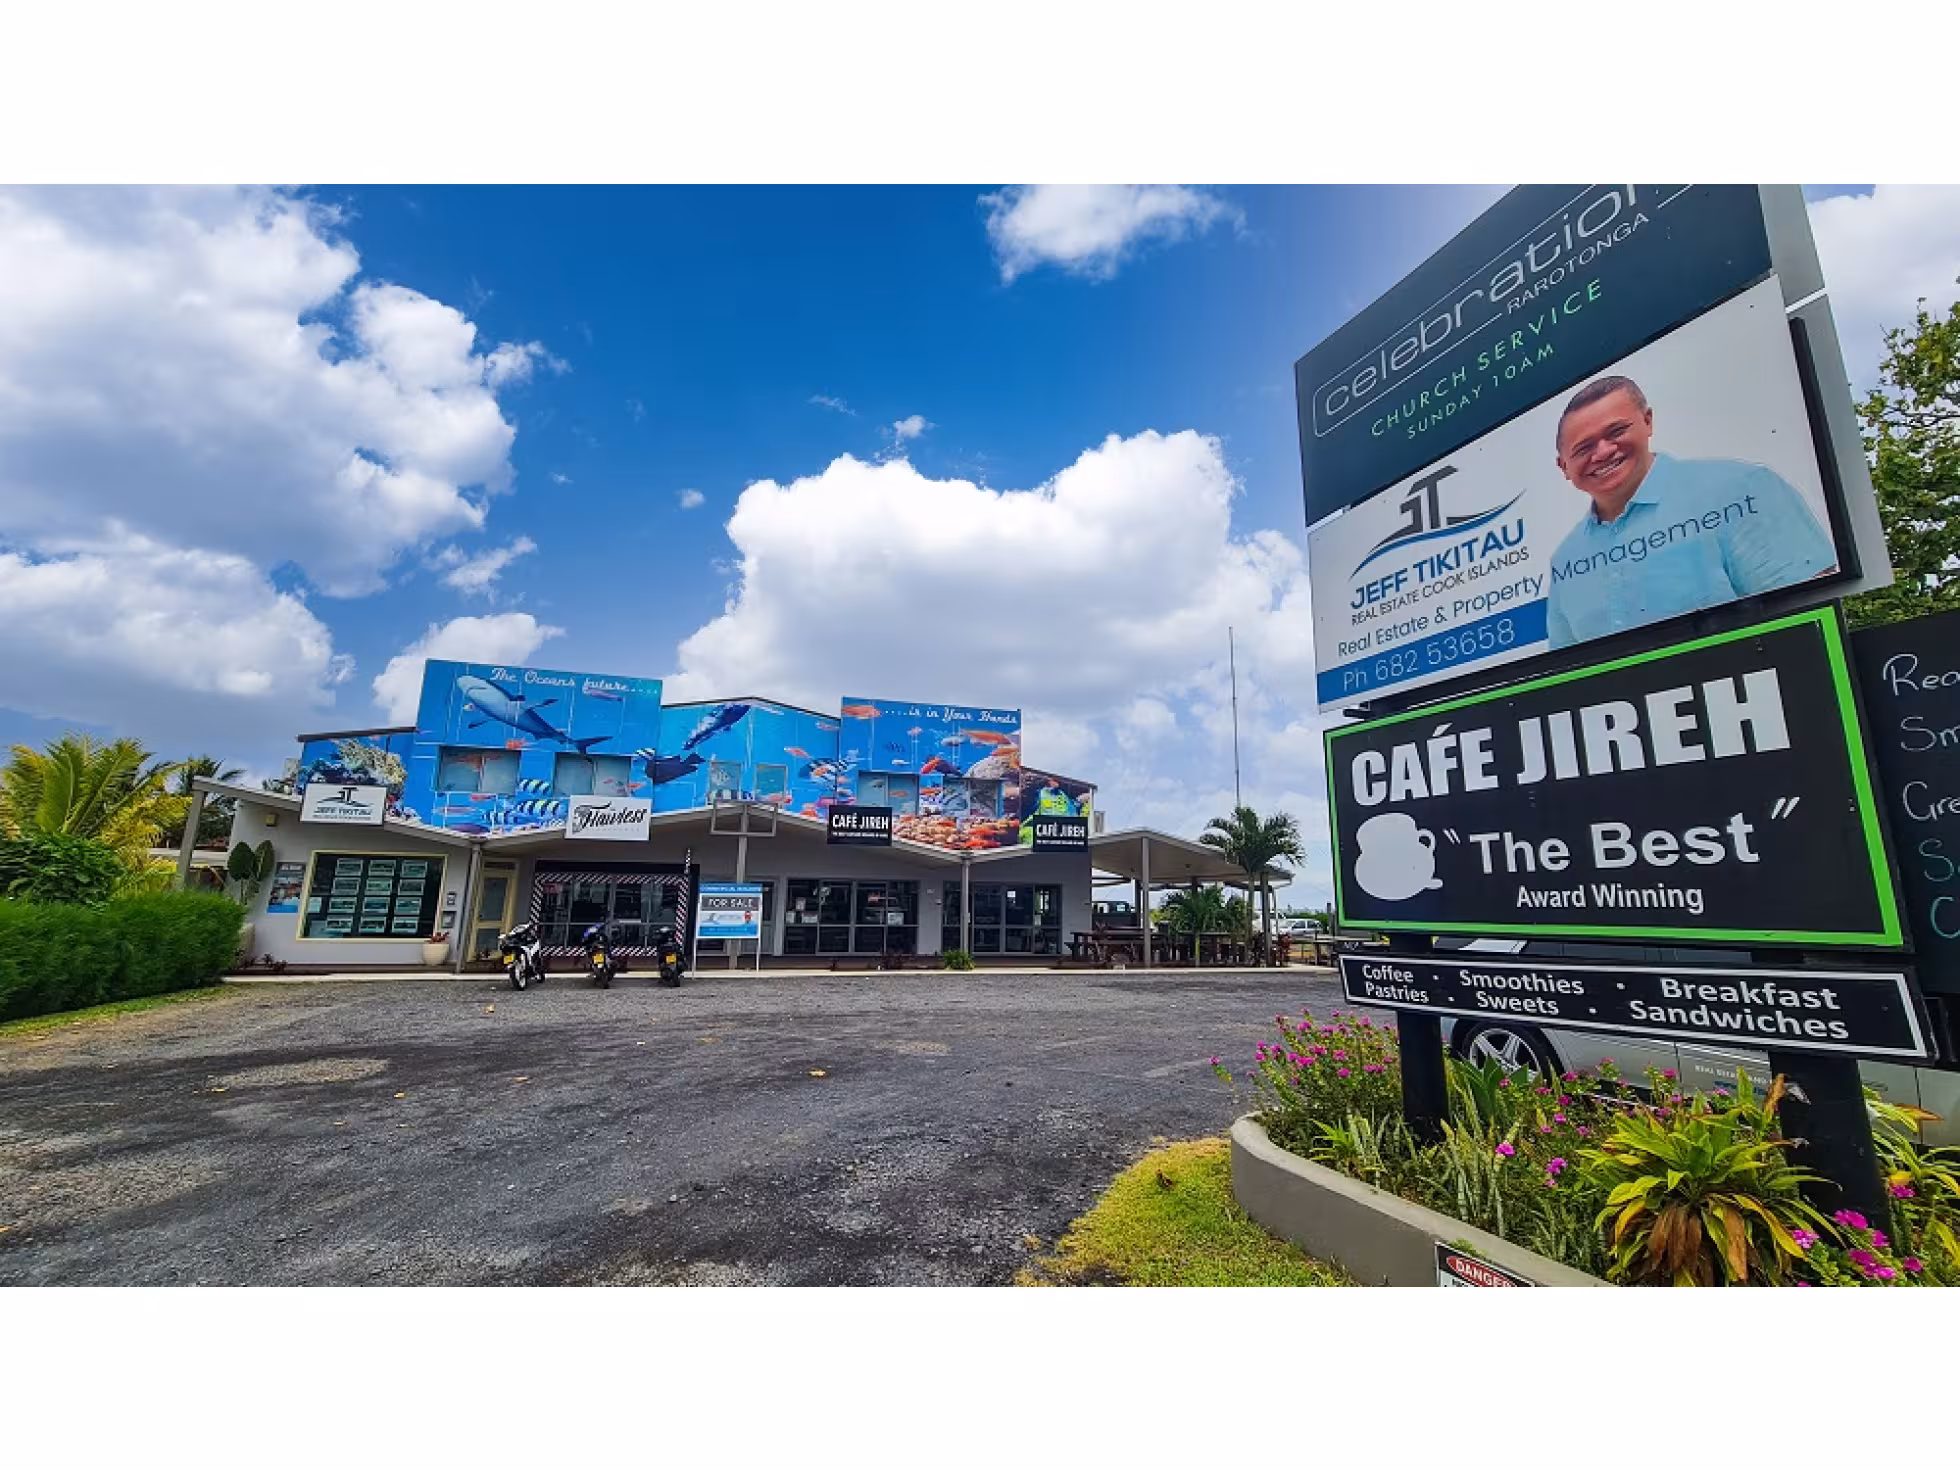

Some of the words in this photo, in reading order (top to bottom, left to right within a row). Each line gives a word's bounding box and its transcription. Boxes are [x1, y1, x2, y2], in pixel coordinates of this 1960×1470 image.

[1508, 212, 1649, 315] RAROTONGA
[1371, 366, 1468, 438] CHURCH
[1477, 279, 1602, 372] SERVICE
[1408, 386, 1482, 440] SUNDAY
[1493, 343, 1556, 388] 10AM
[1338, 632, 1371, 657] Real
[1376, 613, 1429, 645] Estate
[1434, 606, 1448, 624] &
[1453, 573, 1544, 618] Property
[1551, 495, 1759, 584] Management
[1351, 568, 1409, 610] JEFF
[1413, 518, 1524, 583] TIKITAU
[1351, 606, 1378, 627] REAL
[1380, 590, 1420, 616] ESTATE
[1422, 571, 1465, 599] COOK
[1468, 546, 1530, 581] ISLANDS
[489, 667, 518, 682] The
[1343, 667, 1367, 691] Ph
[1375, 649, 1418, 682] 682
[1427, 618, 1516, 666] 53658
[926, 707, 939, 718] in
[1517, 667, 1791, 785] JIREH
[1516, 884, 1587, 909] Award
[1591, 884, 1704, 916] Winning
[1362, 964, 1414, 983] Coffee
[1459, 969, 1585, 996] Smoothies
[1660, 977, 1841, 1010] Breakfast
[1365, 980, 1429, 1004] Pastries
[1475, 990, 1559, 1016] Sweets
[1629, 999, 1849, 1040] Sandwiches
